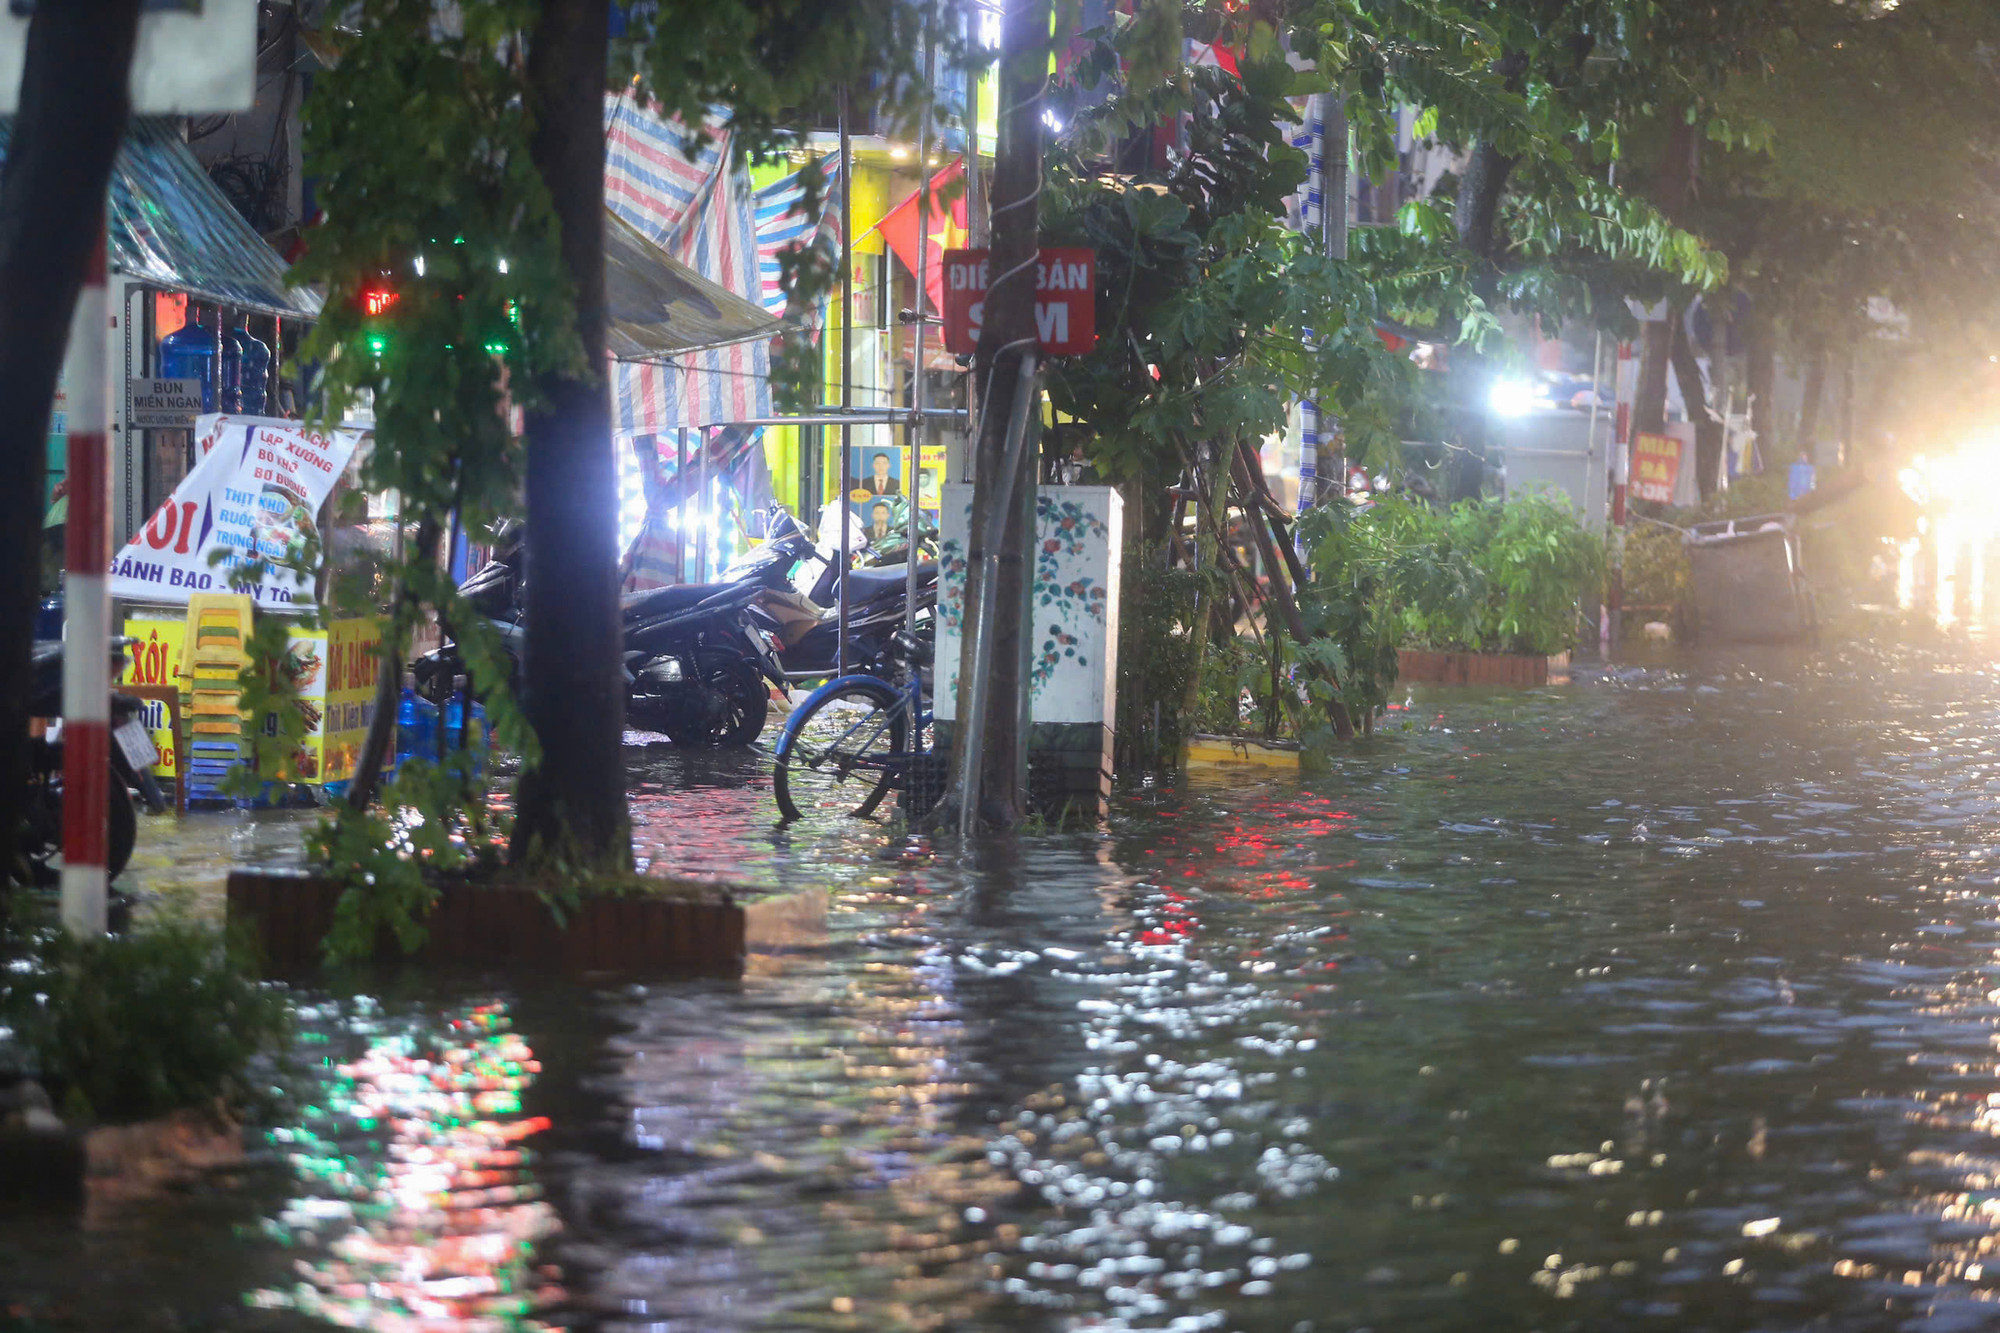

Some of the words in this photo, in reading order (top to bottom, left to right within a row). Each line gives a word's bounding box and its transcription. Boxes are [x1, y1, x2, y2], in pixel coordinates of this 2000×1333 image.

[968, 302, 1069, 343] SM
[167, 396, 202, 408] NGAN
[225, 487, 255, 507] THỊT
[258, 496, 286, 514] KHO
[110, 556, 164, 583] BÁNH
[169, 567, 213, 590] BAO
[271, 586, 295, 603] TÔ
[131, 627, 169, 685] XÔI
